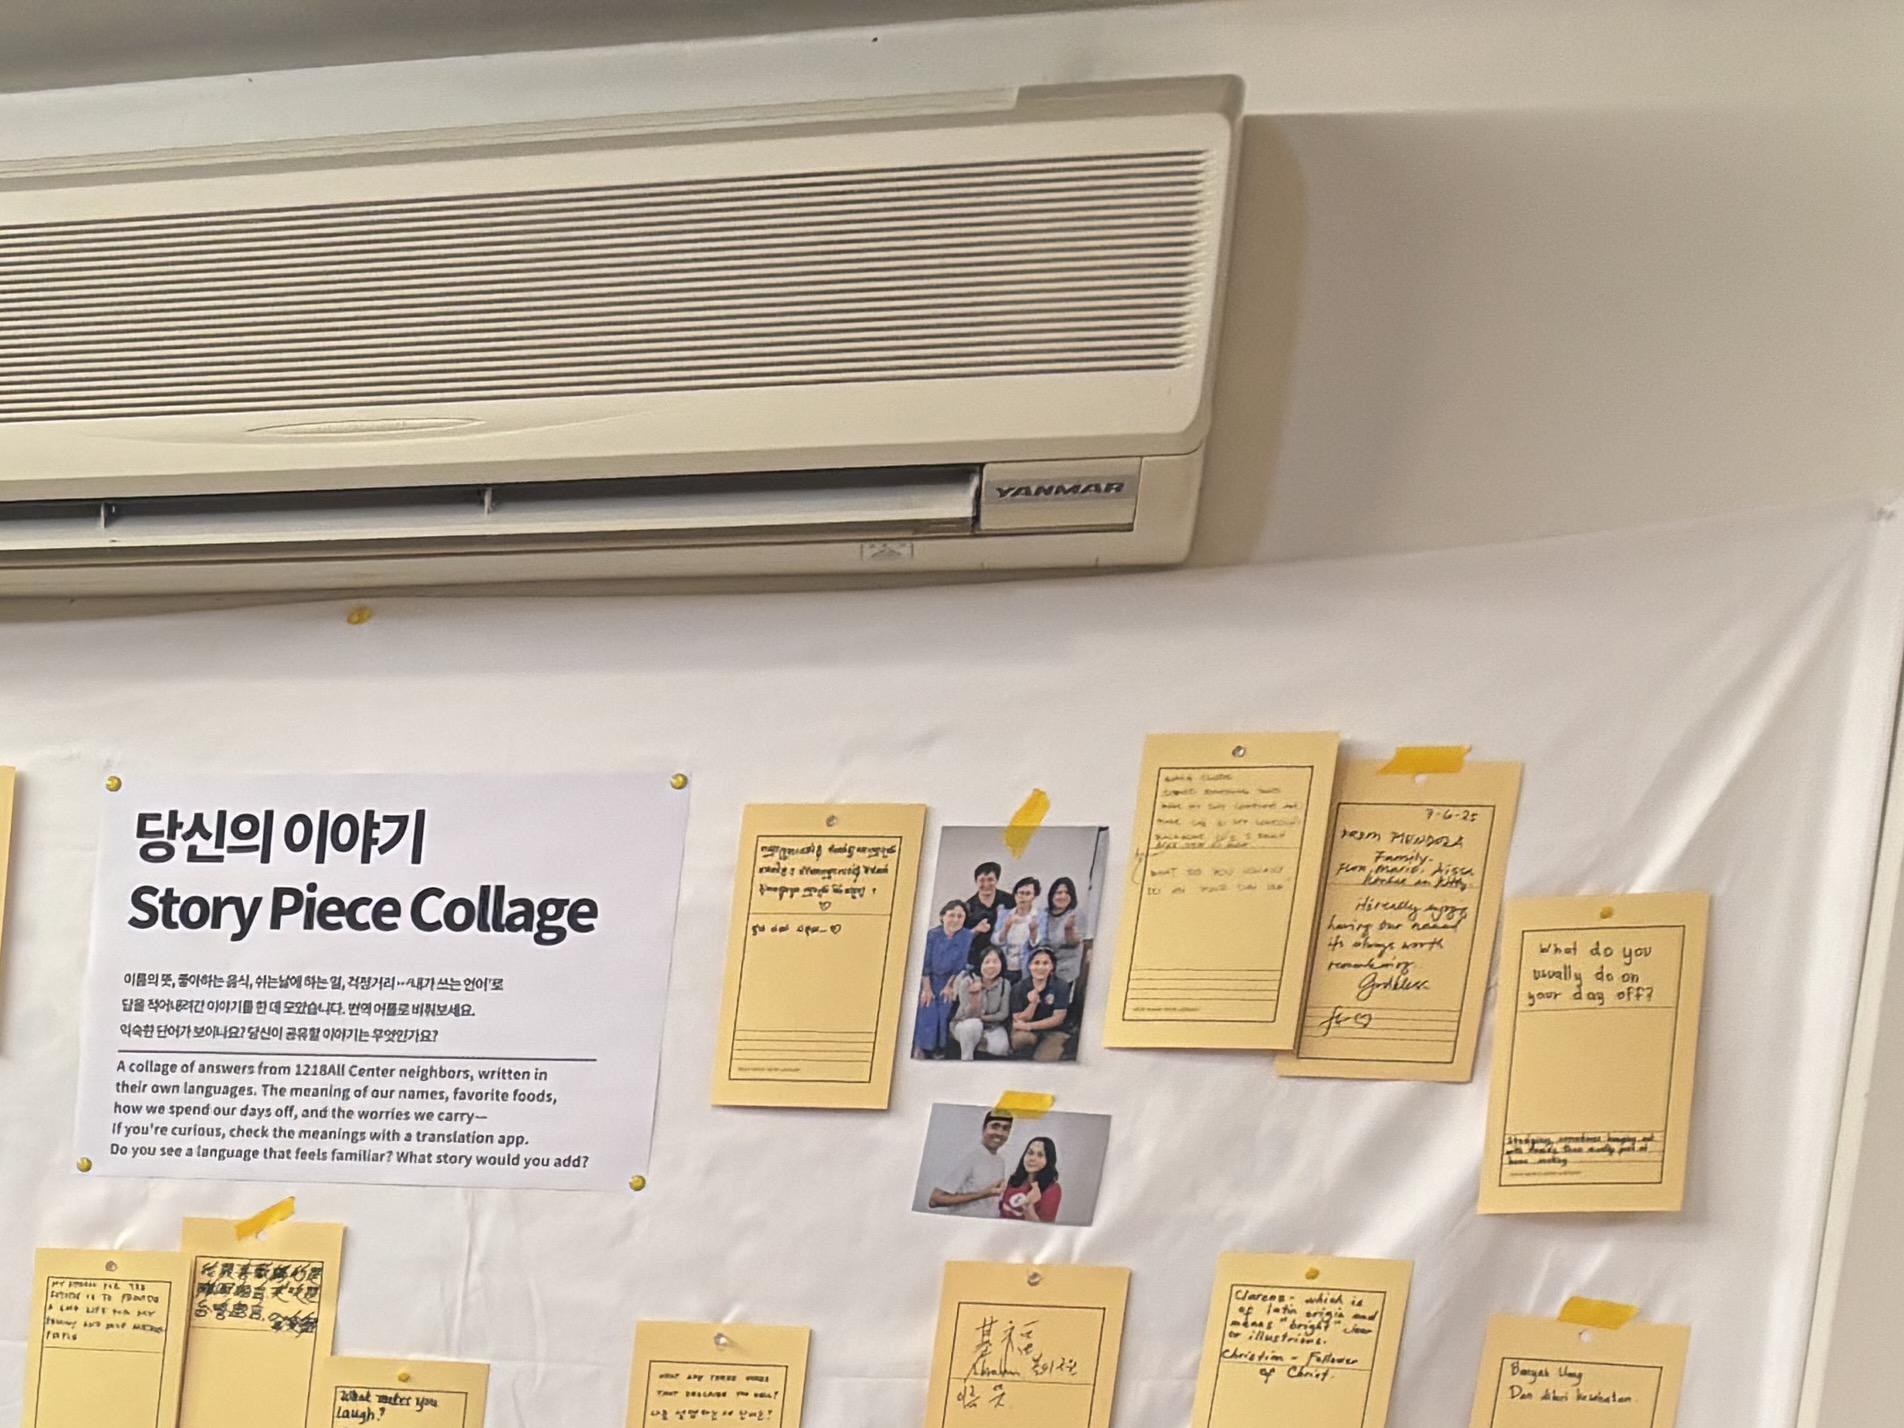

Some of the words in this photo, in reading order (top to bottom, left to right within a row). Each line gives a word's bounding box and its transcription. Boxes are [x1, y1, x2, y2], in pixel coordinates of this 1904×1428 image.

[995, 482, 1124, 498] YANMAR
[136, 810, 274, 864] 당신의
[284, 809, 425, 864] 이야기
[128, 886, 262, 941] Story
[270, 882, 401, 931] Piece
[411, 885, 598, 946] Collage
[1539, 942, 1578, 956] What
[1590, 942, 1614, 957] do
[1622, 946, 1652, 965] you
[1533, 965, 1583, 985] usually
[1595, 965, 1614, 982] do
[1622, 972, 1640, 984] on
[1528, 989, 1561, 1006] your
[1573, 986, 1605, 1005] day
[1617, 987, 1654, 1002] off?
[117, 1060, 125, 1072] A
[129, 1060, 177, 1076] collage
[181, 1060, 195, 1073] of
[198, 1064, 254, 1074] answers
[258, 1062, 290, 1075] from
[349, 1065, 395, 1077] Center
[400, 1066, 474, 1081] neighbors,
[478, 1067, 530, 1080] written
[535, 1068, 547, 1080] in
[116, 1080, 147, 1093] their
[152, 1084, 180, 1094] own
[184, 1082, 256, 1098] languages.
[262, 1084, 286, 1096] The
[290, 1084, 350, 1100] meaning
[354, 1086, 368, 1098] of
[372, 1089, 395, 1098] our
[399, 1090, 448, 1102] names,
[454, 1088, 508, 1101] favorite
[514, 1089, 556, 1104] foods,
[114, 1102, 142, 1114] how
[146, 1105, 165, 1114] we
[169, 1104, 210, 1117] spend
[214, 1107, 236, 1116] our
[240, 1104, 271, 1119] days
[275, 1105, 298, 1120] off,
[302, 1106, 328, 1118] and
[332, 1107, 354, 1119] the
[358, 1108, 410, 1120] worries
[414, 1112, 434, 1121] we
[112, 1122, 122, 1134] If
[172, 1124, 225, 1139] curious,
[230, 1126, 268, 1138] check
[273, 1126, 294, 1139] the
[298, 1128, 366, 1143] meanings
[370, 1129, 400, 1141] with
[404, 1133, 412, 1142] a
[416, 1131, 494, 1144] translation
[498, 1135, 528, 1147] app.
[111, 1144, 128, 1155] Do
[132, 1146, 156, 1158] you
[160, 1147, 182, 1156] see
[186, 1148, 192, 1156] a
[197, 1145, 259, 1161] language
[264, 1147, 291, 1159] that
[296, 1148, 327, 1160] feels
[332, 1148, 393, 1162] familiar?
[396, 1151, 432, 1163] What
[436, 1153, 472, 1168] story
[476, 1154, 520, 1166] would
[524, 1158, 550, 1169] you
[554, 1155, 589, 1168] add?
